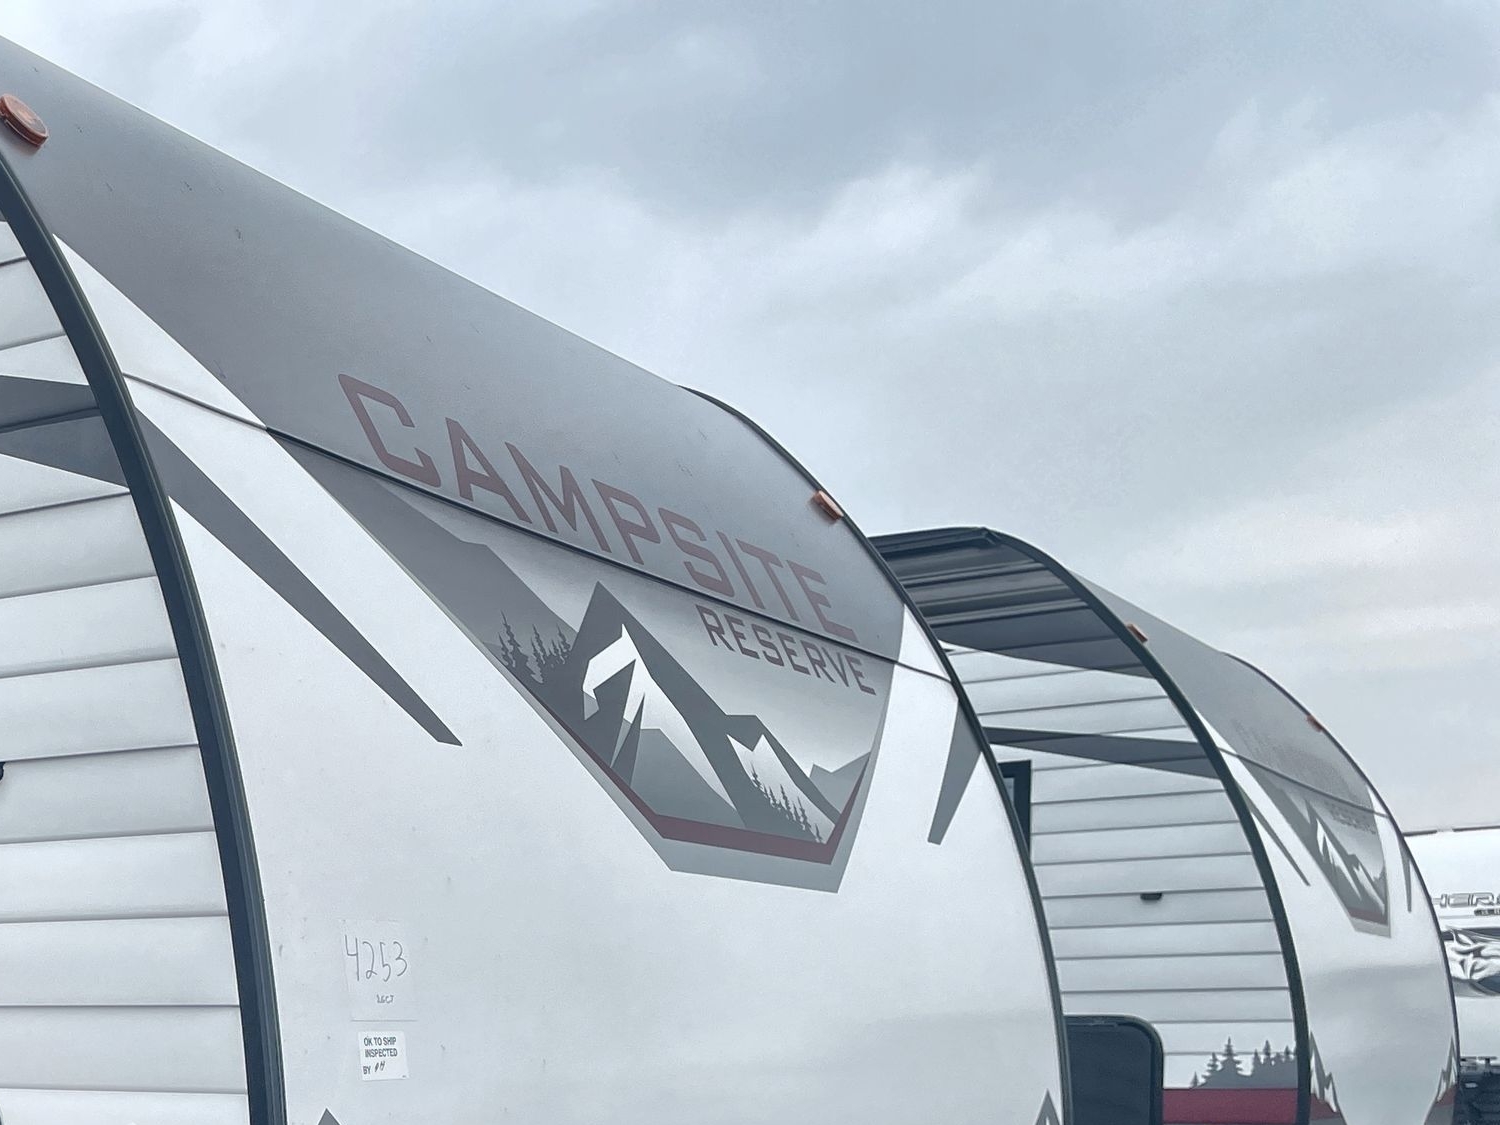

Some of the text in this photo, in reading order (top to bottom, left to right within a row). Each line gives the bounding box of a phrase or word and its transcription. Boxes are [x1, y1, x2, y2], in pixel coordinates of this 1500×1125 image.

[338, 373, 859, 643] CAMPSITE
[696, 604, 877, 696] RESERVE
[345, 935, 407, 982] 4253
[363, 1036, 397, 1046] OK TO SHIP
[365, 1048, 398, 1057] INSPECTED
[363, 1066, 371, 1075] BY
